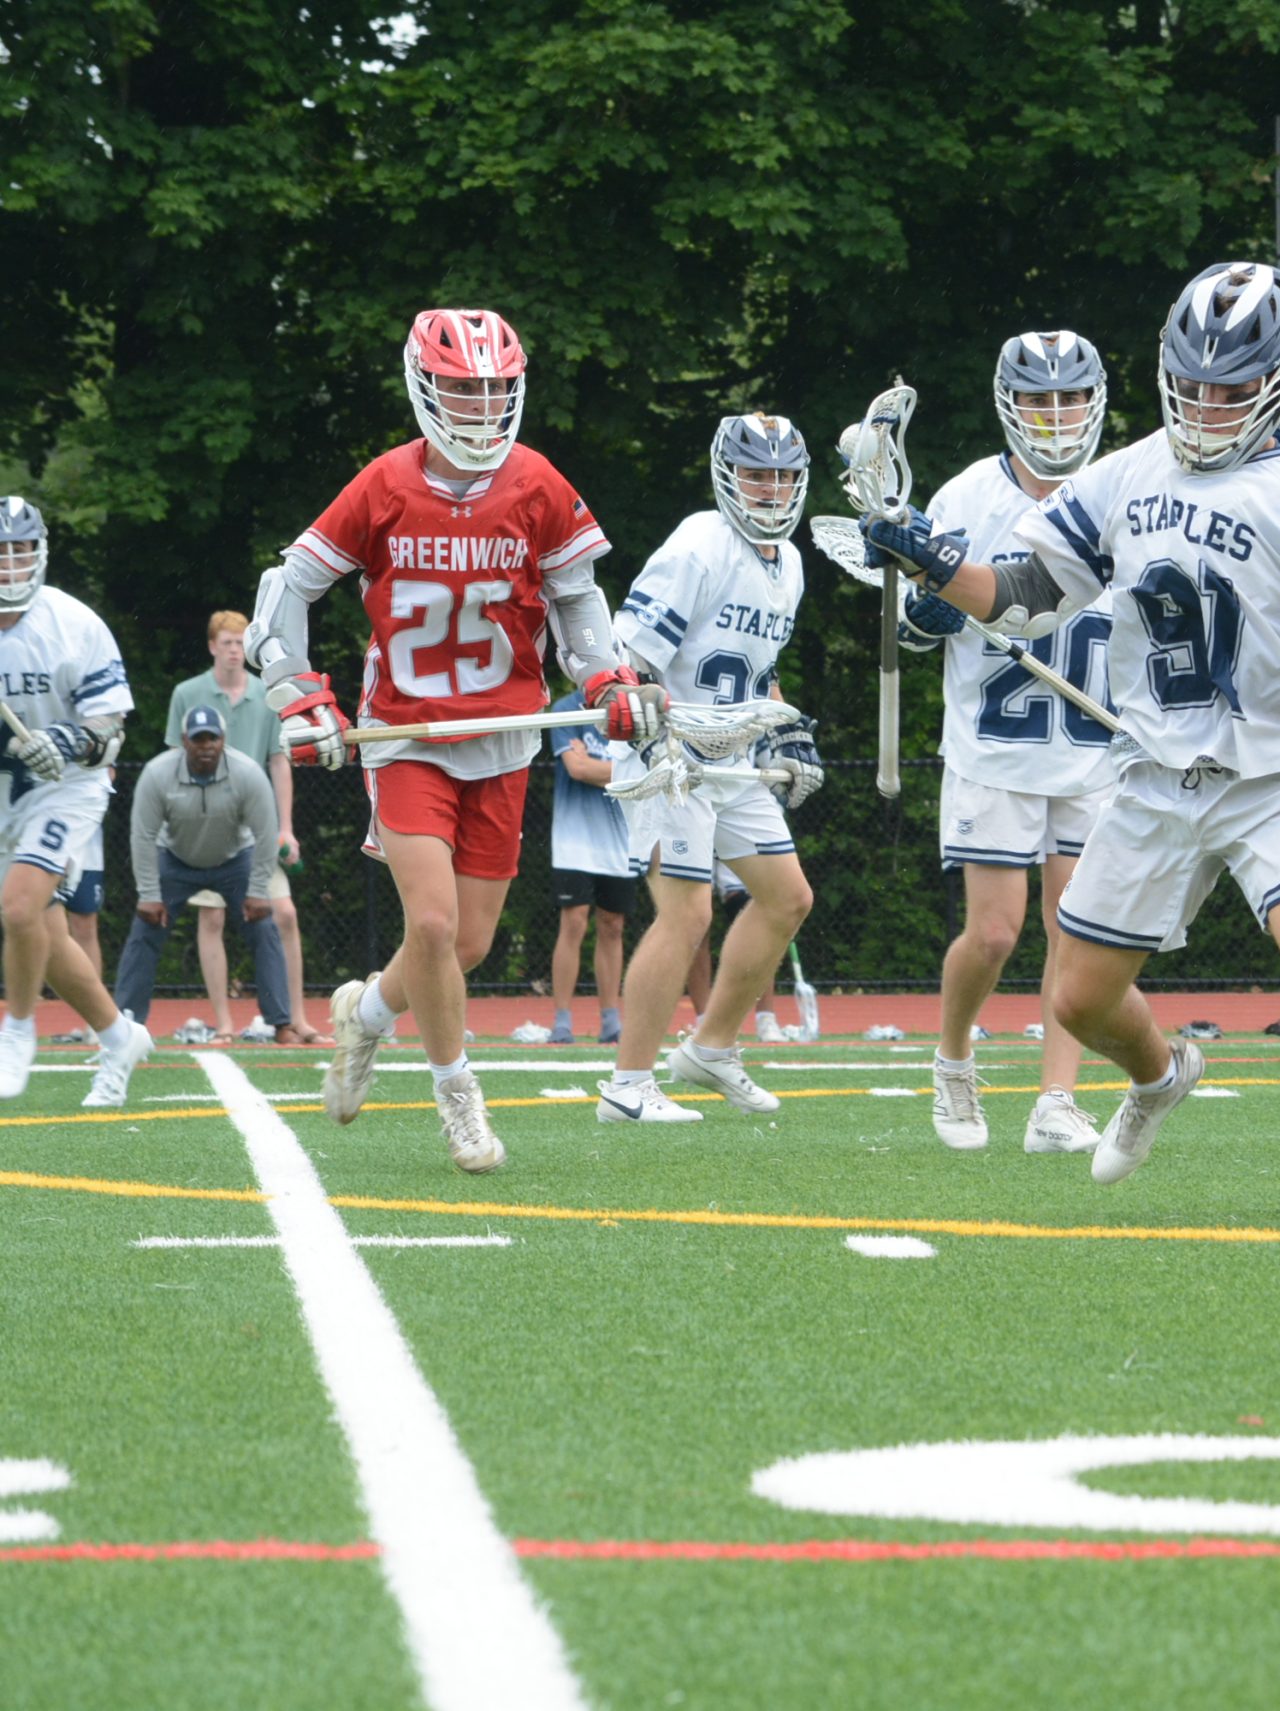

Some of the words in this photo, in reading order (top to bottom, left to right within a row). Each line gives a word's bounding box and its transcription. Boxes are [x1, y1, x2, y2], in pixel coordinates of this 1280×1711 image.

[1127, 493, 1256, 562] STAPLES
[388, 536, 528, 571] GREENWICH
[937, 545, 961, 566] S
[635, 600, 670, 629] S
[716, 603, 795, 642] STAPLE
[388, 579, 514, 698] 25
[581, 628, 597, 648] STX
[975, 610, 1119, 749] 20
[39, 820, 68, 851] S
